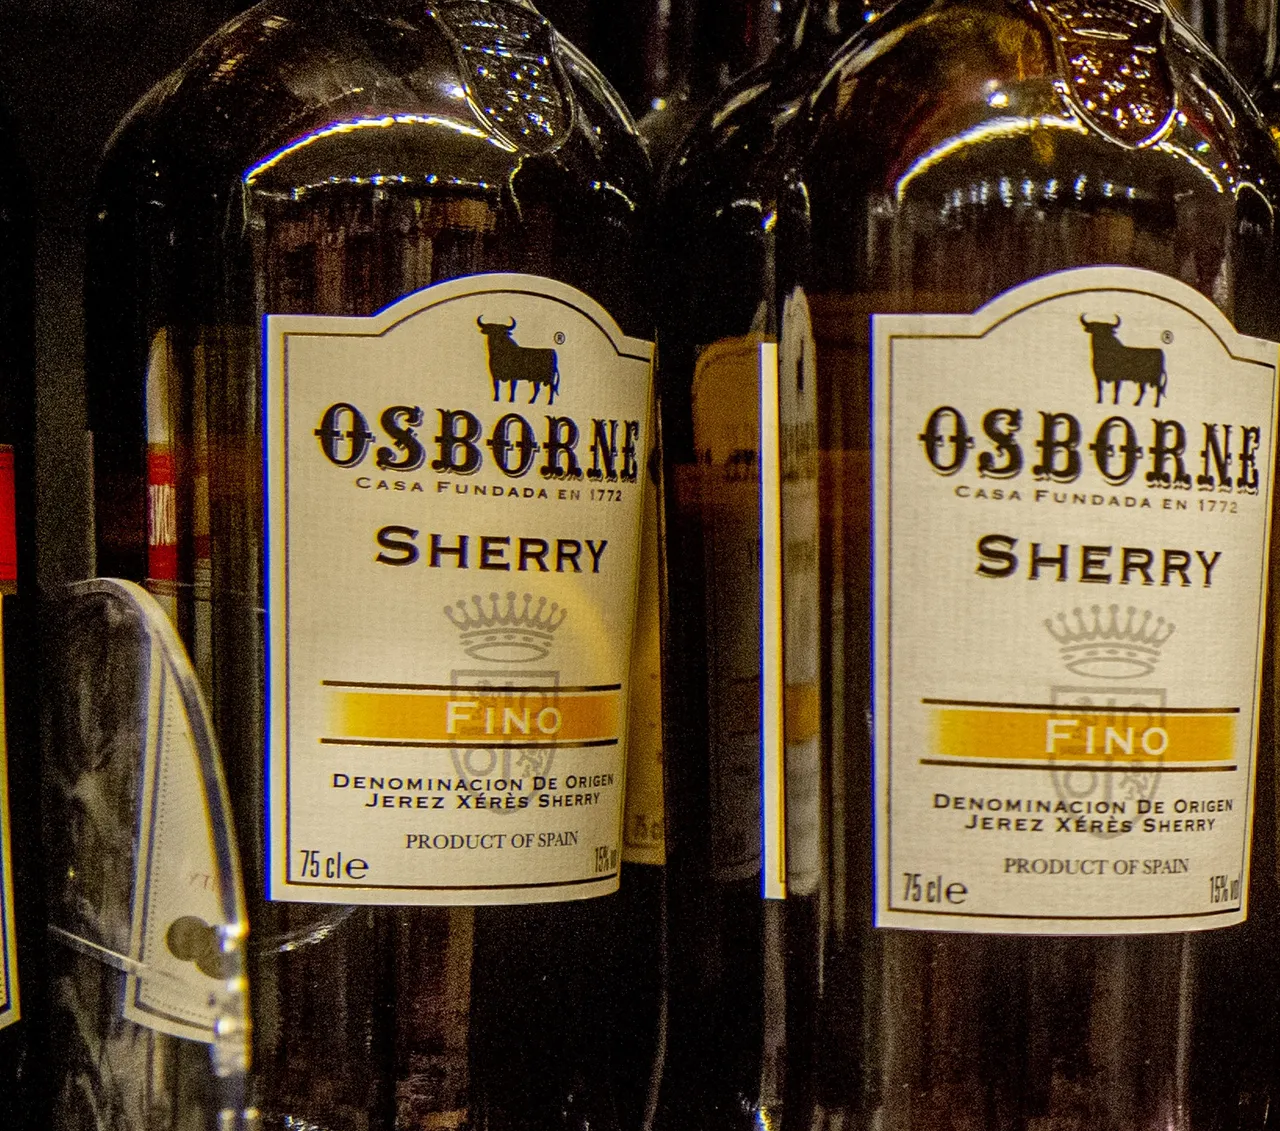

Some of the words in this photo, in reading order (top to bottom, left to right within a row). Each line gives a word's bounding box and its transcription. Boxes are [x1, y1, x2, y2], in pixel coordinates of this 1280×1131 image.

[314, 402, 639, 484] OSBORNE
[918, 405, 1260, 496] OSBORNE
[356, 476, 424, 493] CASA
[437, 480, 548, 499] FUNDADA
[558, 489, 581, 501] EN
[590, 489, 622, 502] 1772
[955, 486, 1022, 501] CASA
[1035, 490, 1151, 509] FUNDADA
[1162, 500, 1187, 510] EN
[1199, 500, 1238, 513] 1772
[375, 525, 608, 573] SHERRY
[976, 534, 1222, 587] SHERRY
[446, 701, 562, 735] FINO
[1045, 719, 1169, 756] FINO
[333, 773, 522, 791] DENOMINACION
[534, 776, 556, 790] DE
[566, 773, 614, 788] ORIGEN
[365, 793, 444, 809] JEREZ
[539, 792, 600, 808] SHERRY
[934, 793, 1125, 814] DENOMINACION
[1137, 799, 1164, 814] DE
[1174, 798, 1233, 813] ORIGEN
[965, 814, 1043, 832] JEREZ
[1144, 817, 1215, 832] SHERRY
[406, 833, 507, 849] PRODUCT
[515, 833, 535, 848] OF
[538, 831, 578, 847] SPAIN
[300, 851, 319, 878] 75
[1004, 857, 1107, 875] PRODUCT
[1113, 858, 1139, 875] OF
[1143, 858, 1189, 873] SPAIN
[904, 873, 922, 902] 75
